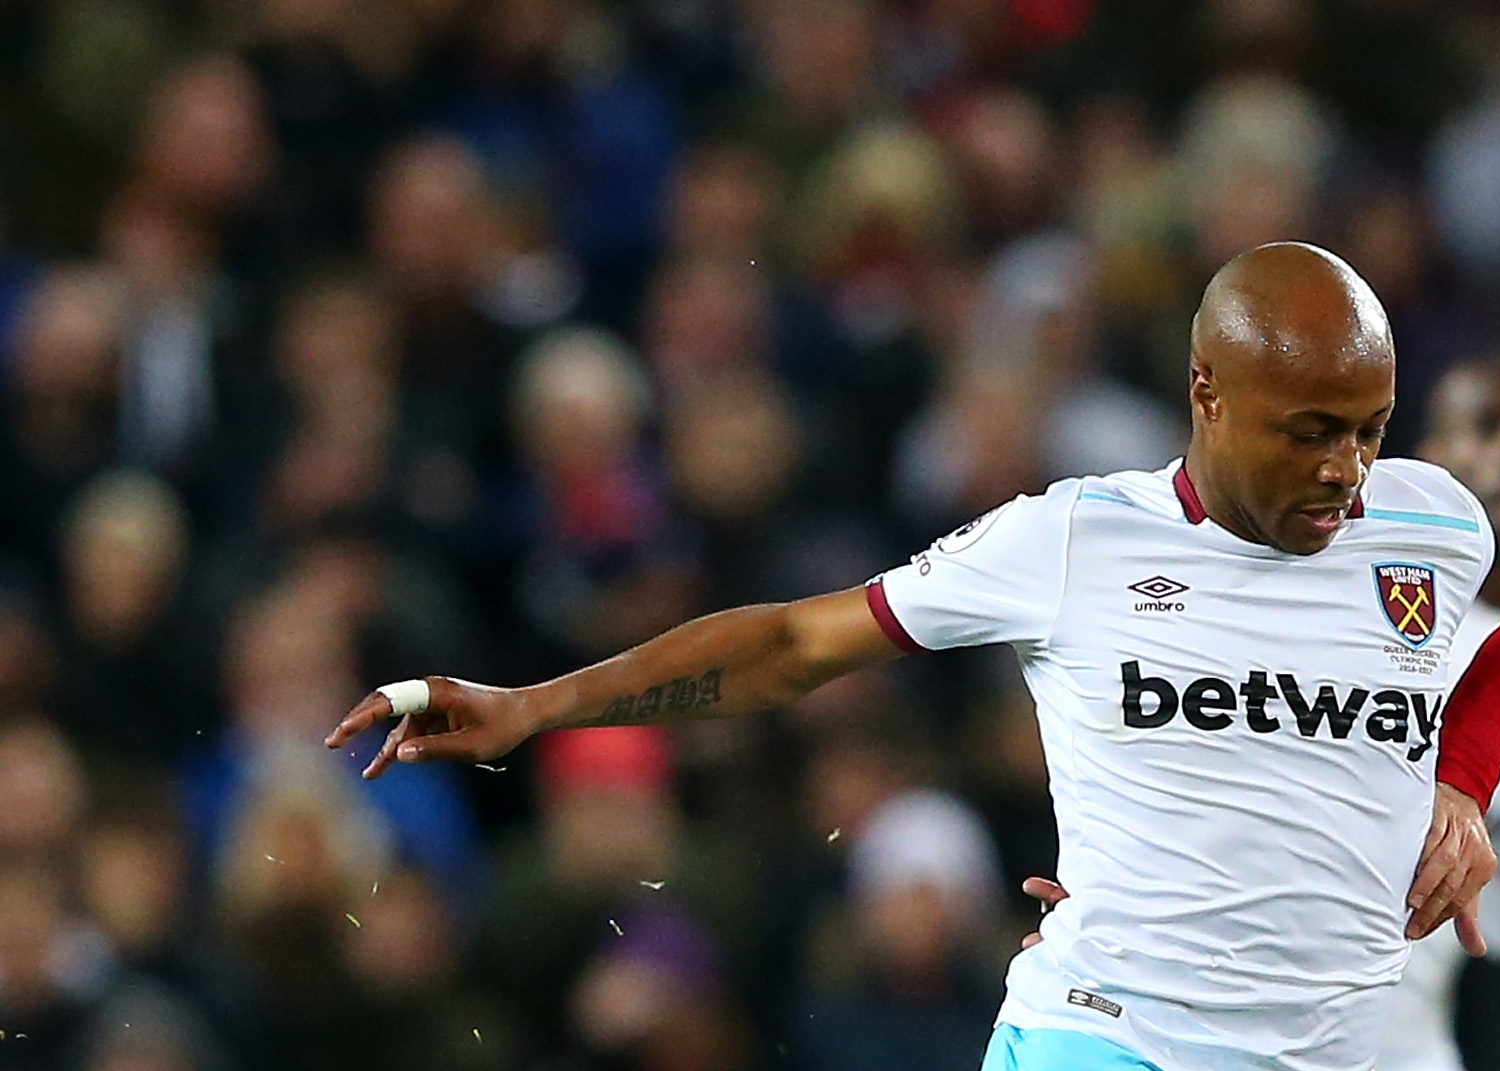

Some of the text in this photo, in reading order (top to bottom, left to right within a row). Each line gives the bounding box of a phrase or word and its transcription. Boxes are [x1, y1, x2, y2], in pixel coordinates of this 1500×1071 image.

[1379, 567, 1430, 580] WEST HAM
[1135, 600, 1185, 612] umbro
[1121, 660, 1441, 762] betway
